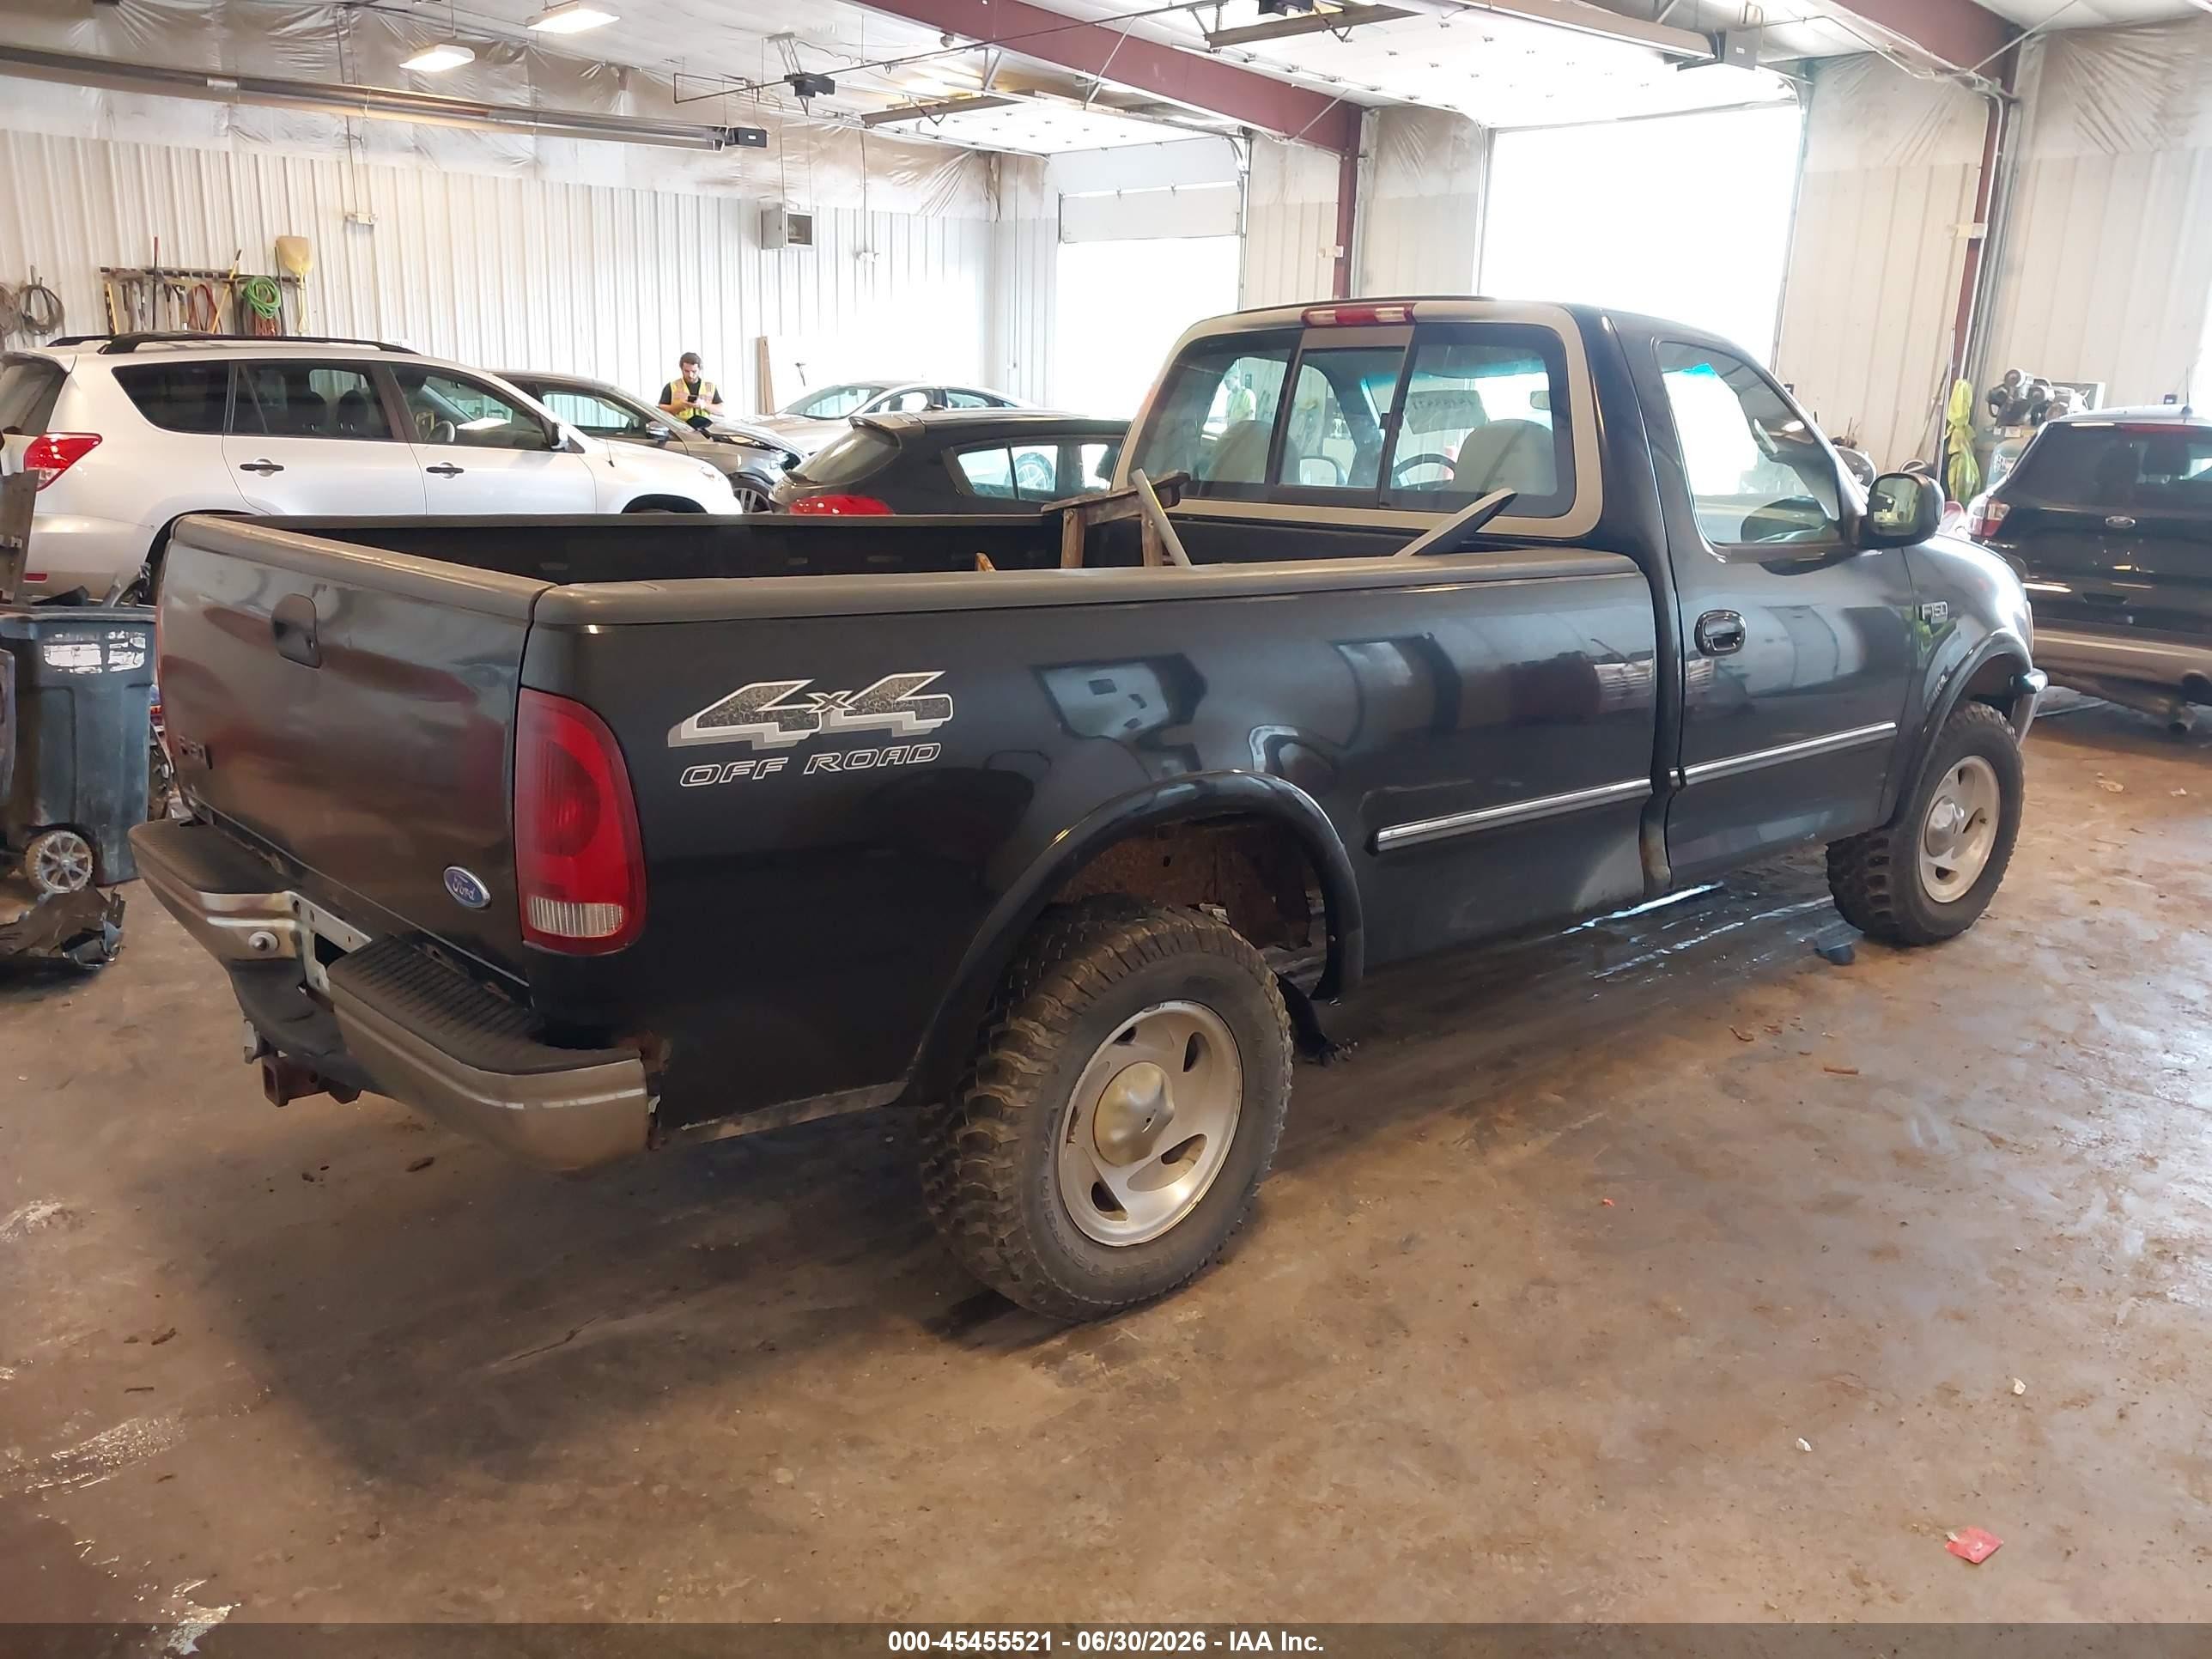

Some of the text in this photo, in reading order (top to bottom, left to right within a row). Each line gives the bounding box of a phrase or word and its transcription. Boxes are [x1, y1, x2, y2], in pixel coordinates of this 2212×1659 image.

[679, 742, 942, 787] OFF ROAD
[452, 873, 475, 901] Ford
